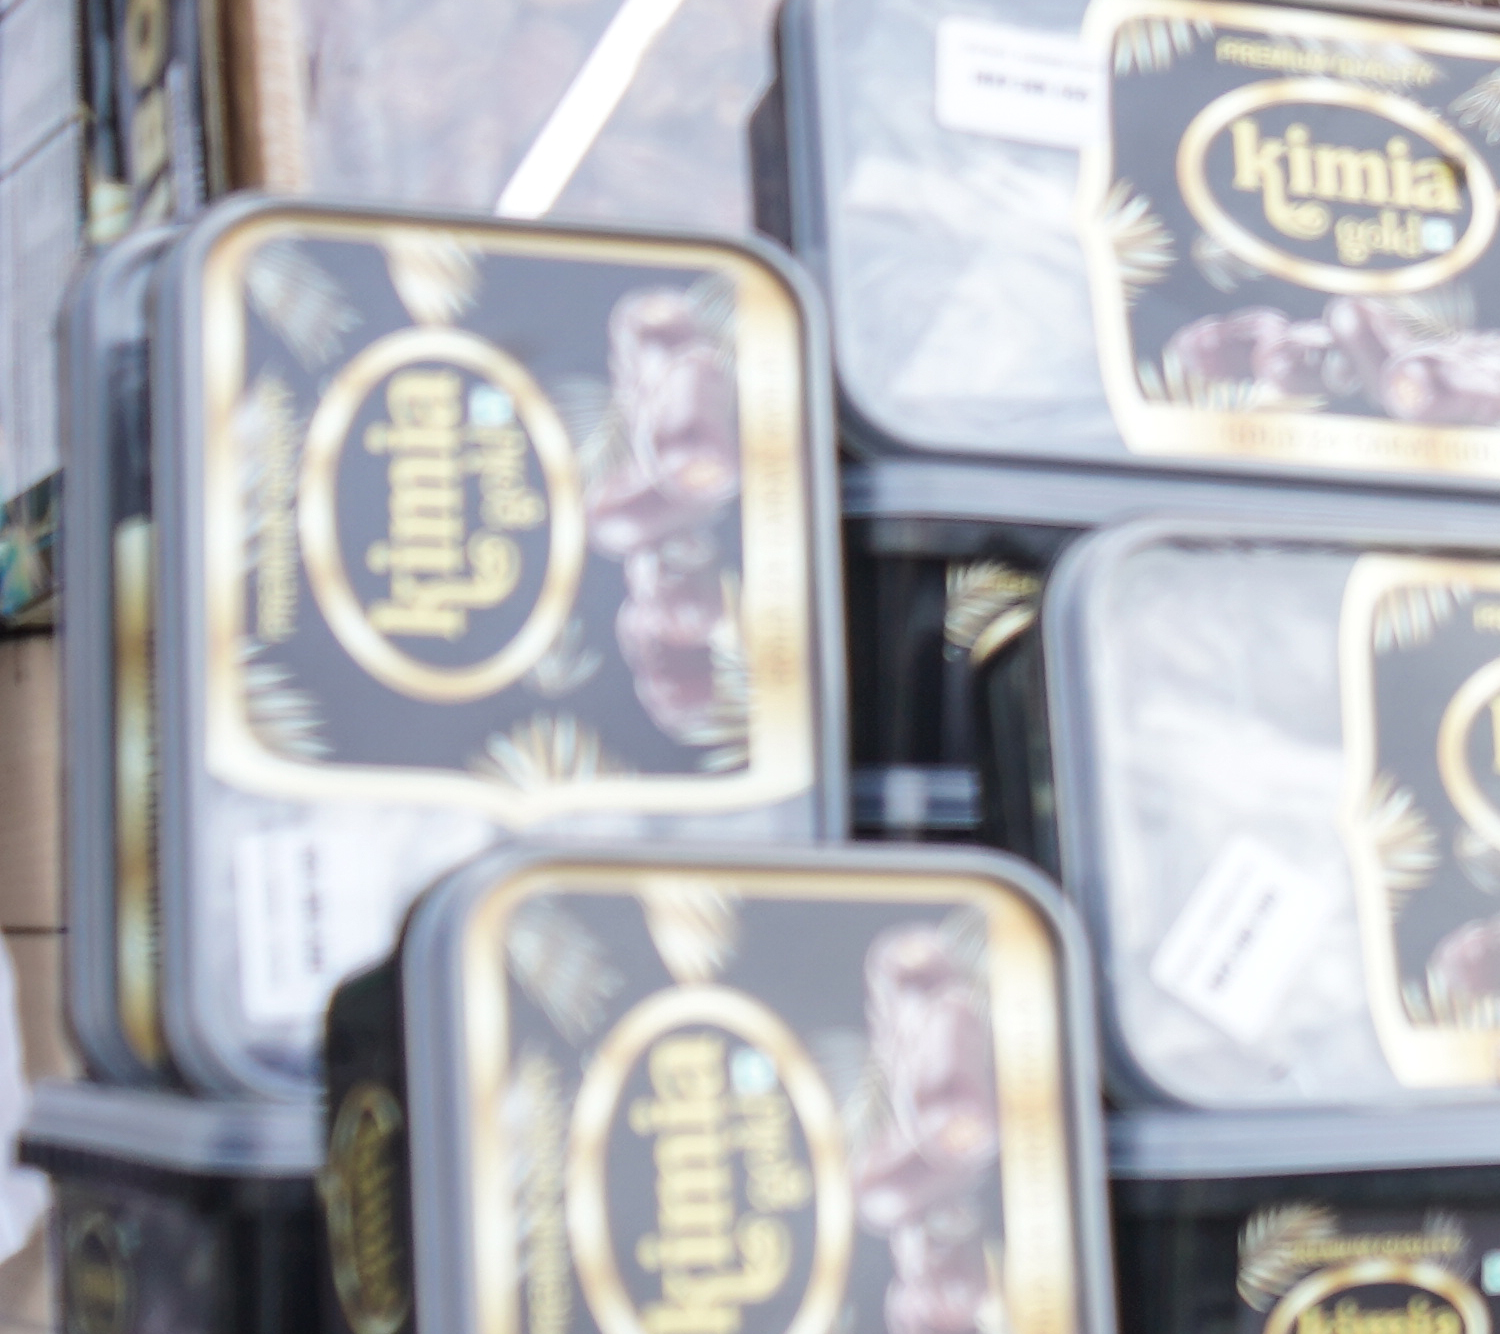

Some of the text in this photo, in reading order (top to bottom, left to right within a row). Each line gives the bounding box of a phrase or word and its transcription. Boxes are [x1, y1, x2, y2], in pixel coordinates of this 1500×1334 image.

[1230, 118, 1463, 239] kimia
[1335, 209, 1423, 266] gold
[368, 370, 523, 641] kimia
